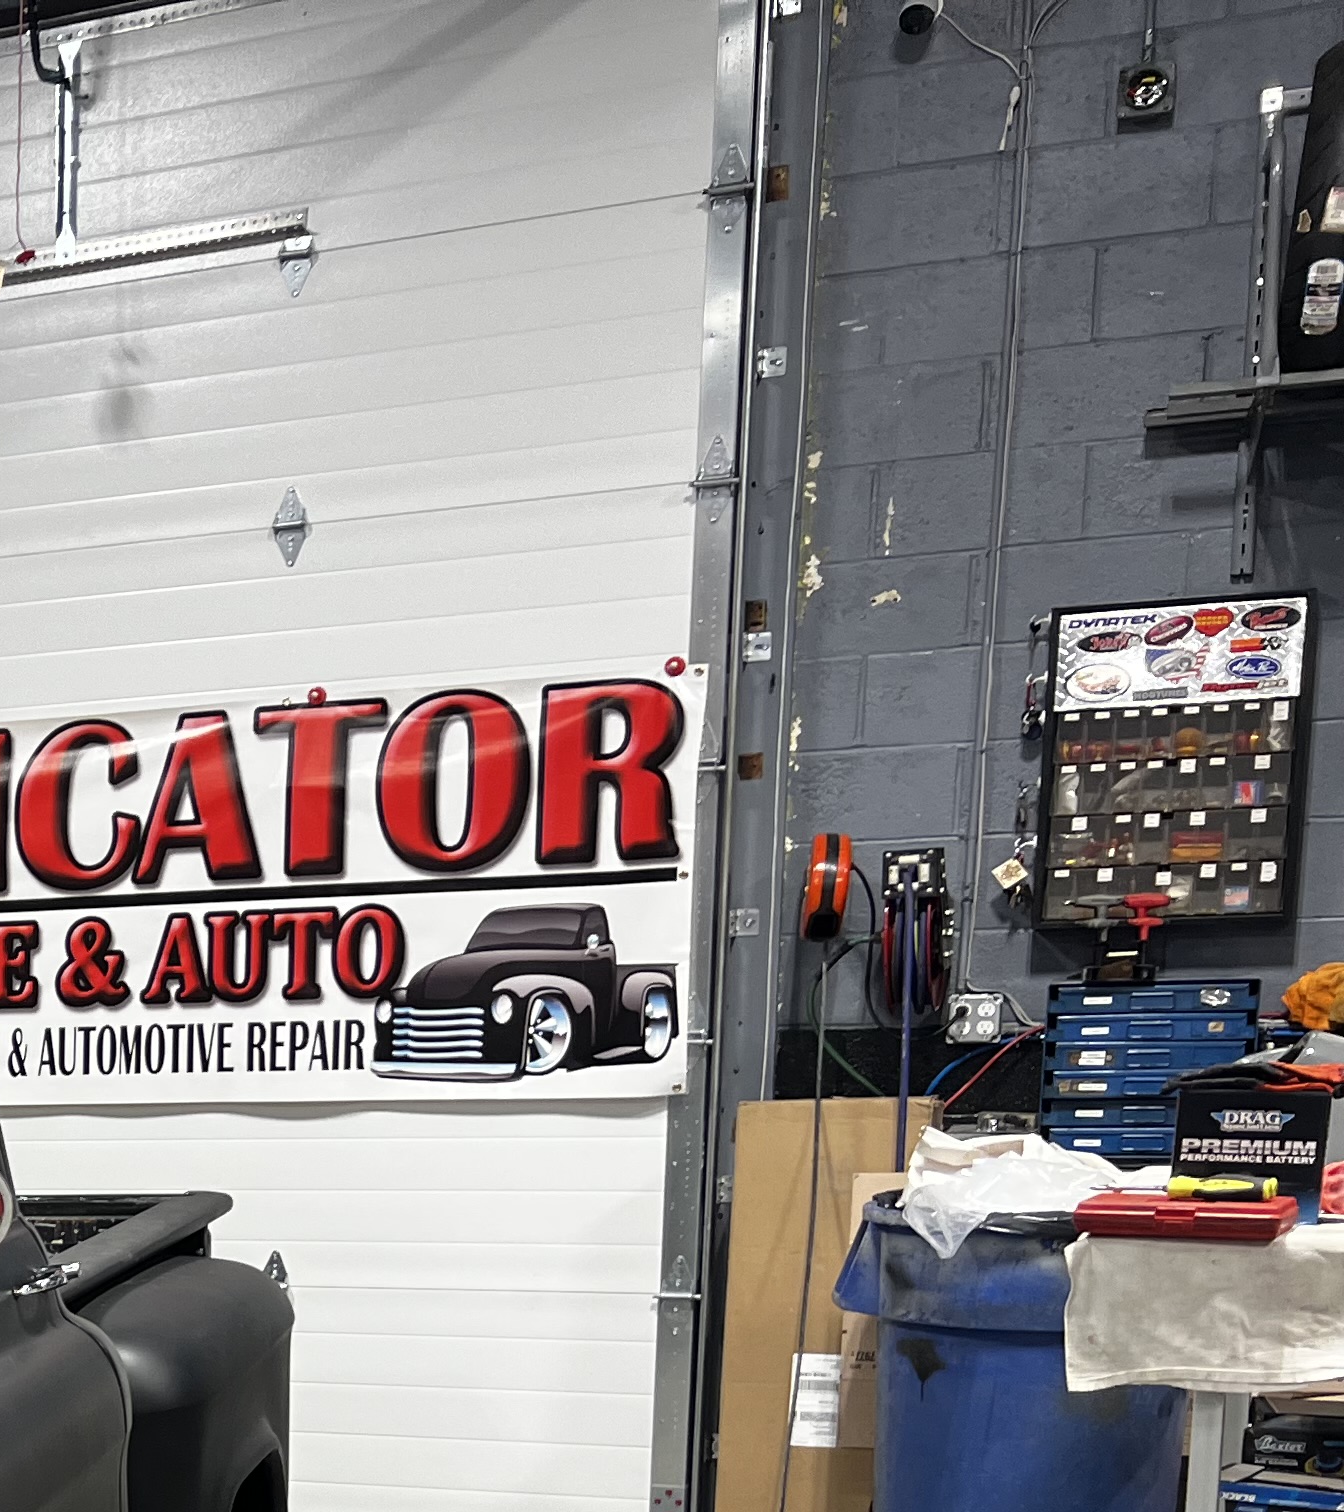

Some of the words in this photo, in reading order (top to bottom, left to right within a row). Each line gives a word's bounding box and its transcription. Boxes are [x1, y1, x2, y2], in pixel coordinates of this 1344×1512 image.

[1067, 614, 1160, 629] DYNATEK
[55, 914, 129, 1007] &
[143, 903, 407, 1004] AUTO
[5, 1026, 29, 1076] &
[38, 1021, 235, 1077] AUTOMOTIVE
[245, 1020, 367, 1072] REPAIR
[1224, 1111, 1281, 1125] DRAG
[1180, 1138, 1318, 1157] PREMIUM
[1179, 1154, 1263, 1164] PERFORMANCE
[1265, 1155, 1317, 1165] BATTERY
